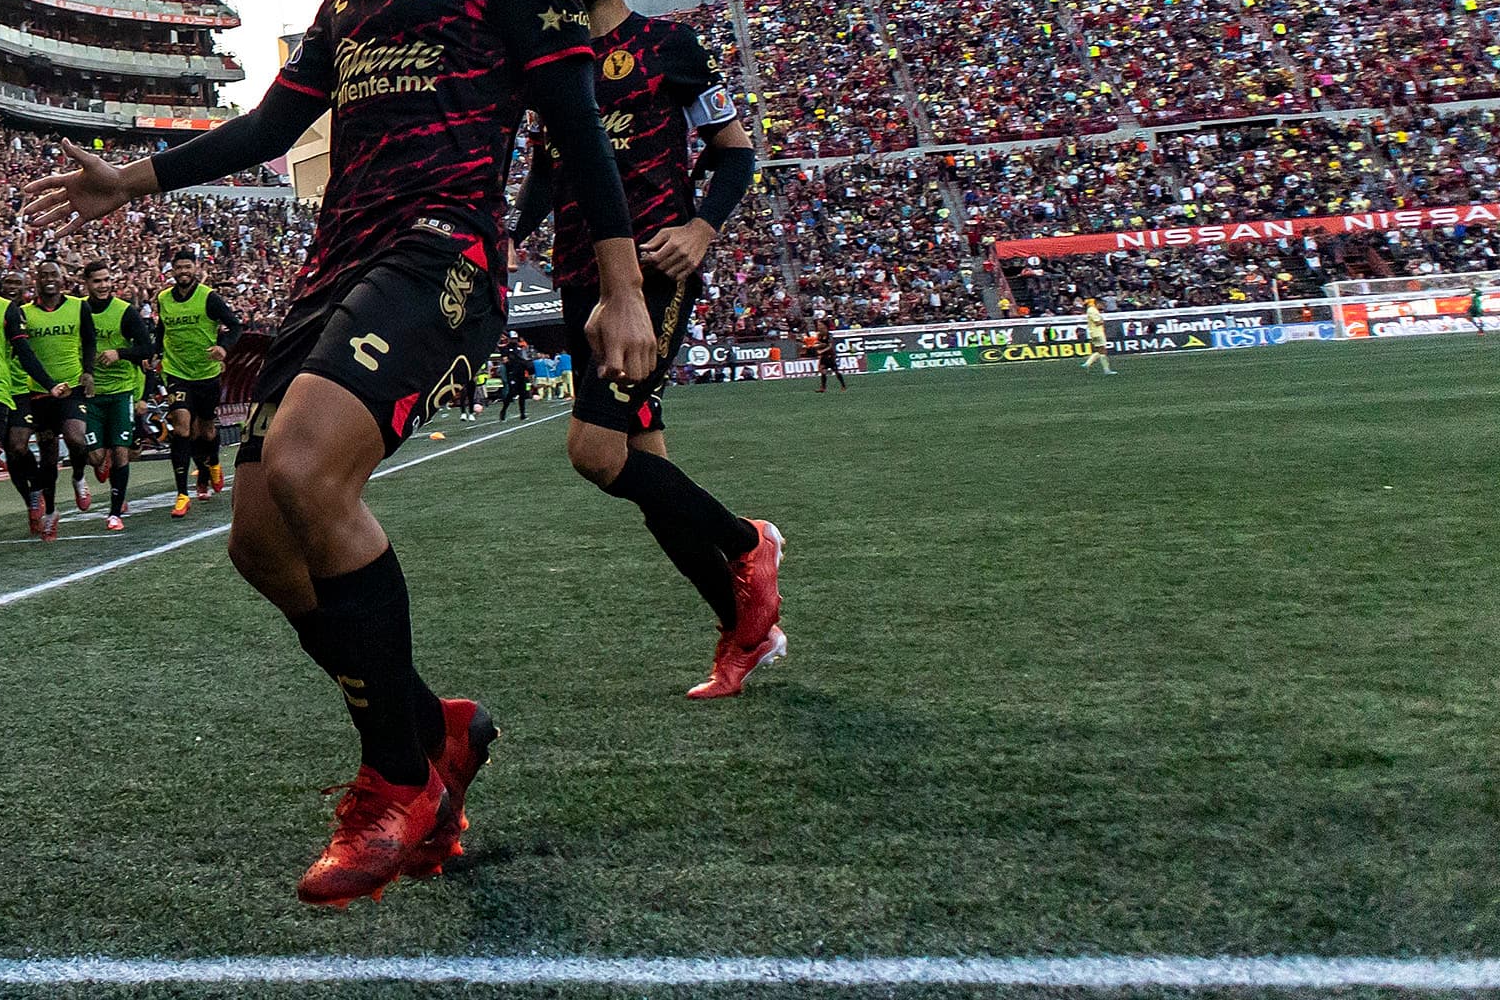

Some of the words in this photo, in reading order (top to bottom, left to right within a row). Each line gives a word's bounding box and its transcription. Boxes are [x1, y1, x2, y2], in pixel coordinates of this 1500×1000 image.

[1345, 204, 1500, 231] NISSA
[1117, 221, 1294, 248] NISSAN
[1003, 343, 1092, 361] CARIBU
[784, 360, 819, 374] DUTY
[911, 357, 967, 368] MEXICANA
